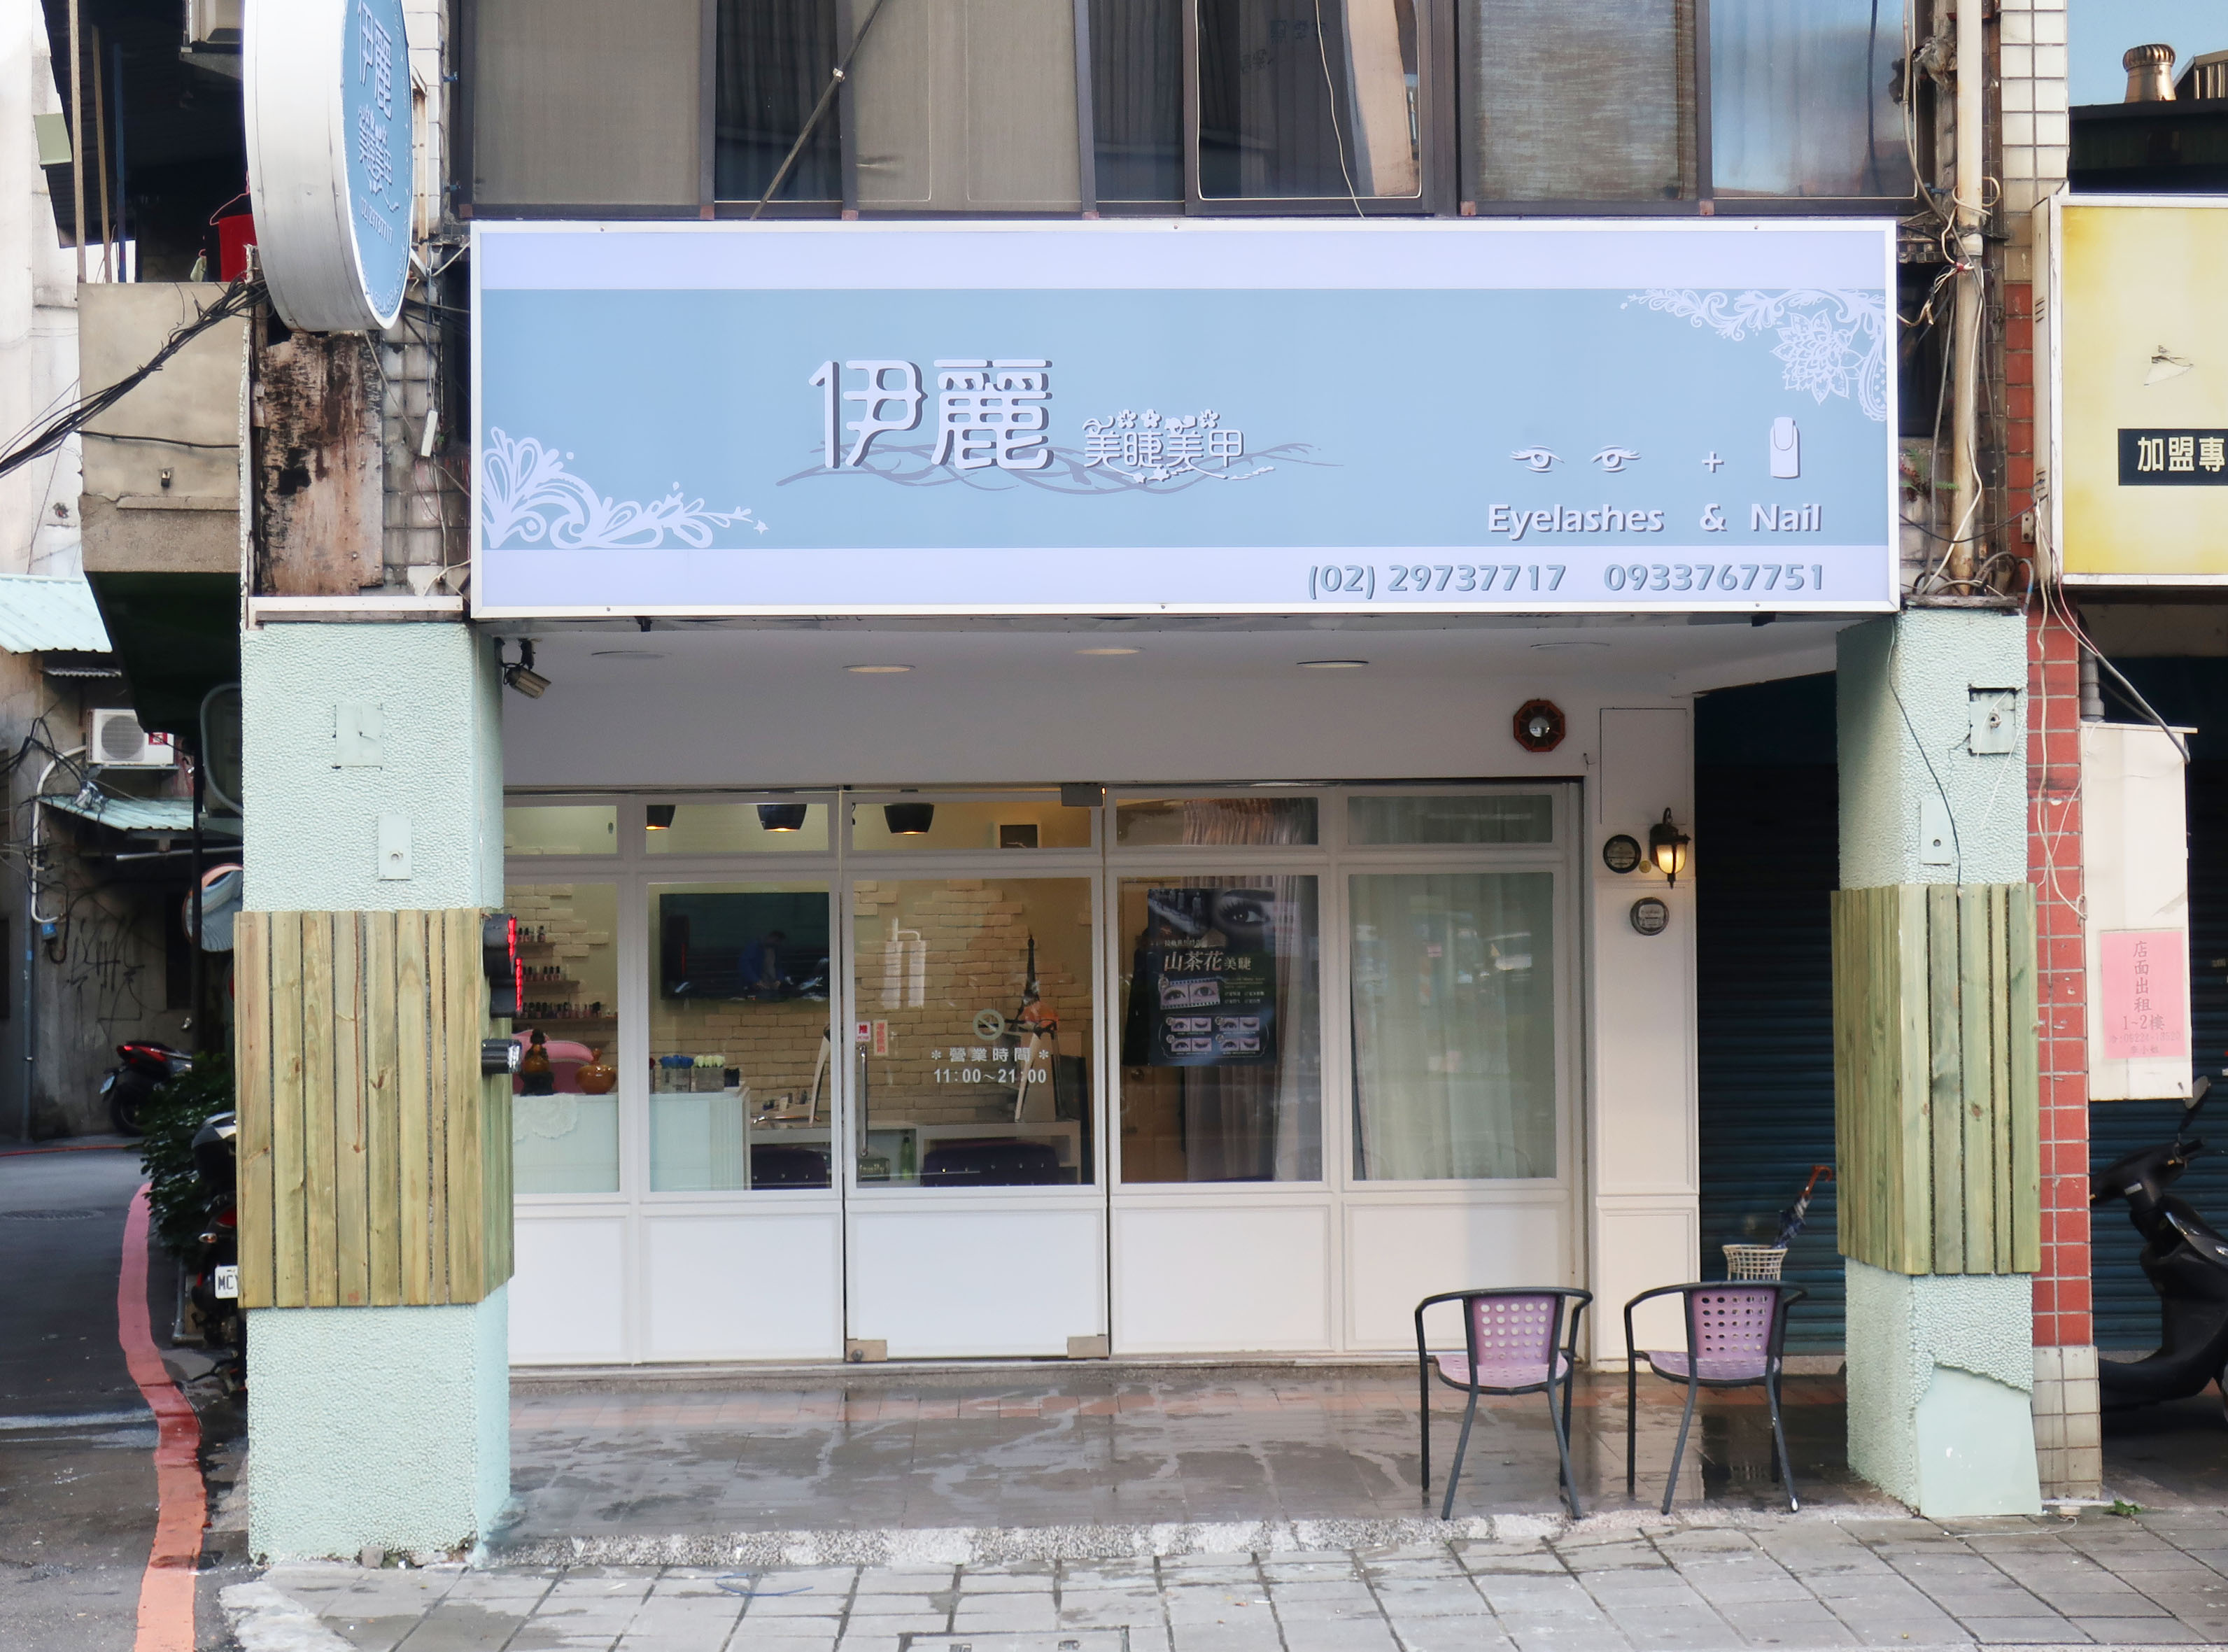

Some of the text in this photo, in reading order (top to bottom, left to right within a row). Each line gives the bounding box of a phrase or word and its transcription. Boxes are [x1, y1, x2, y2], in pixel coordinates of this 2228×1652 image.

[809, 358, 1246, 470] 伊麗 美睫美甲
[2137, 436, 2225, 472] 加盟專
[1488, 503, 1821, 541] Eyelashes & Nail
[1308, 563, 1823, 600] (02) 29737717 0933767751
[2133, 940, 2152, 1012] 店面出租
[950, 1047, 1031, 1063] 營業時間
[933, 1068, 1047, 1084] 11:00~21:00
